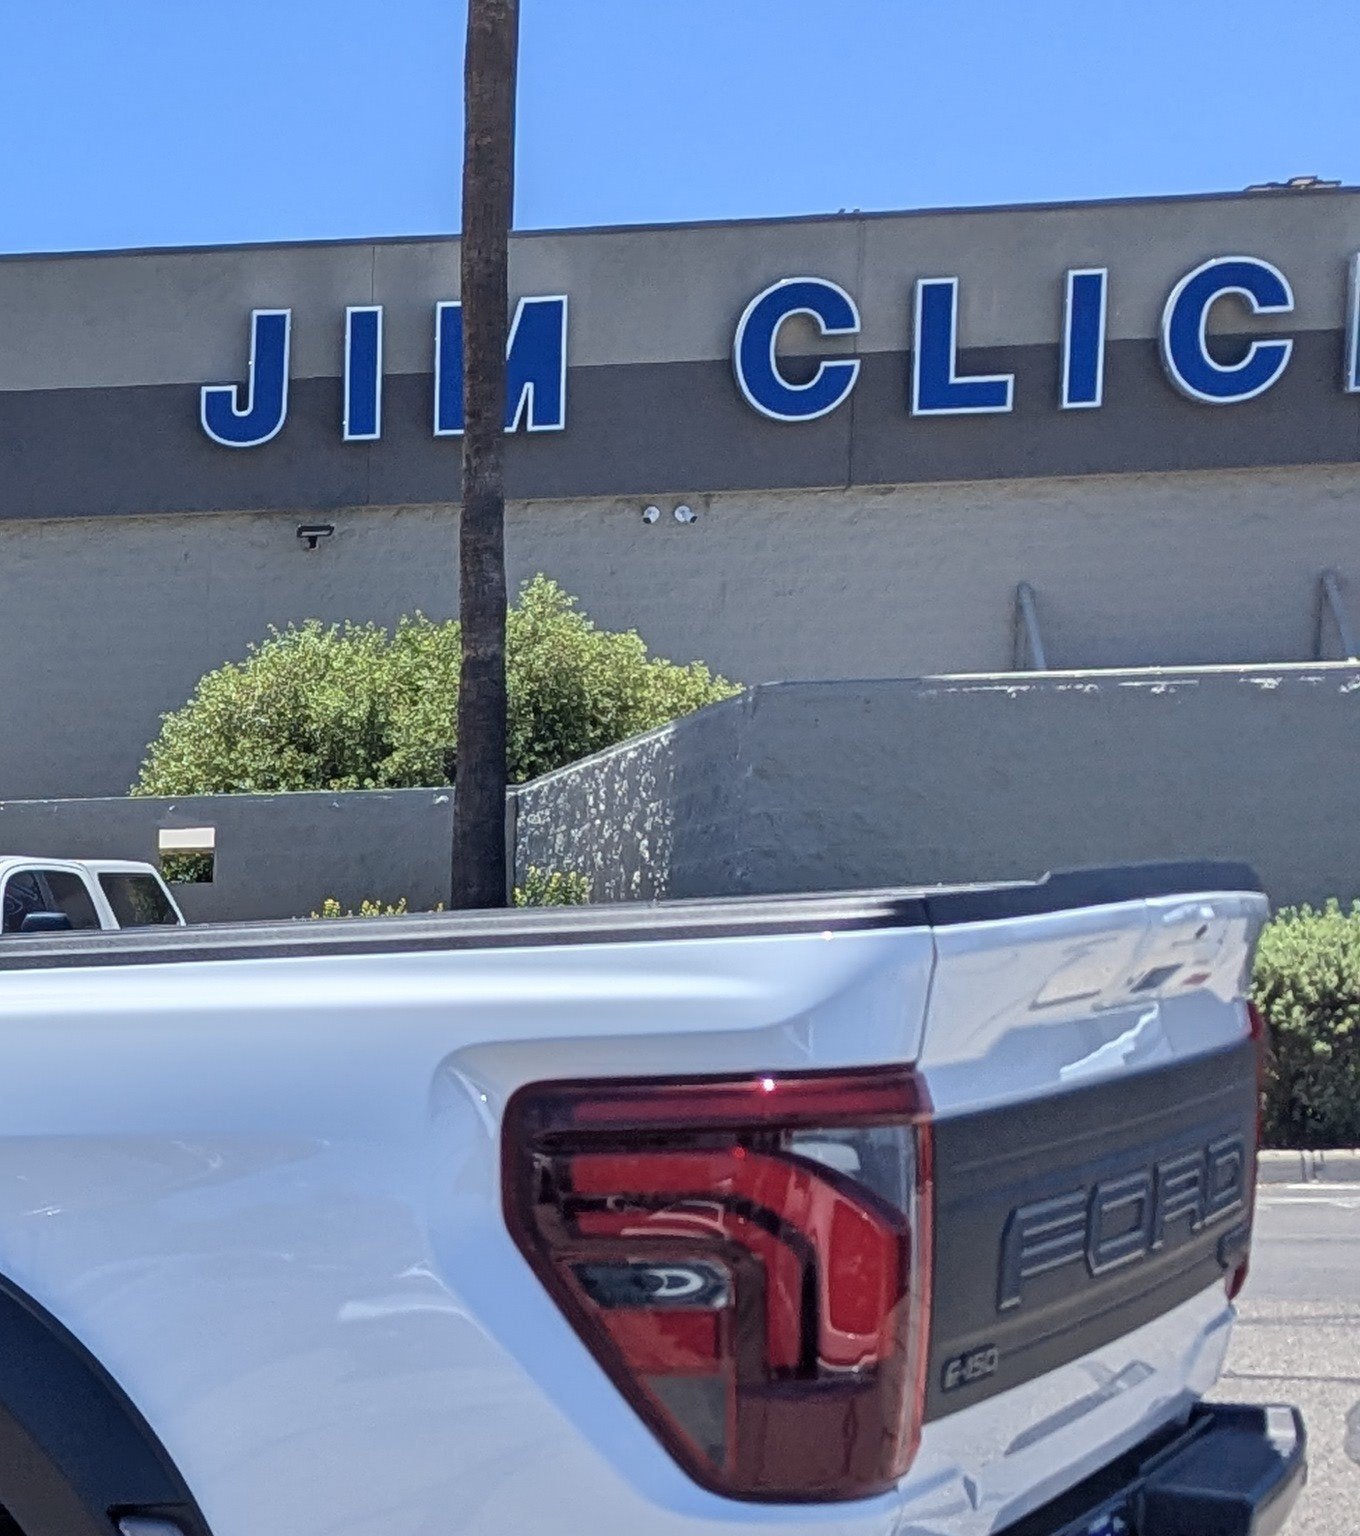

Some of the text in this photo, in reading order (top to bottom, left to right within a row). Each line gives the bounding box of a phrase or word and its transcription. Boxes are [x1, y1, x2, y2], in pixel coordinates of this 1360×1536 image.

[199, 251, 1360, 448] JIM CLIC
[996, 1131, 1244, 1311] FORD
[942, 1346, 999, 1391] F-150
